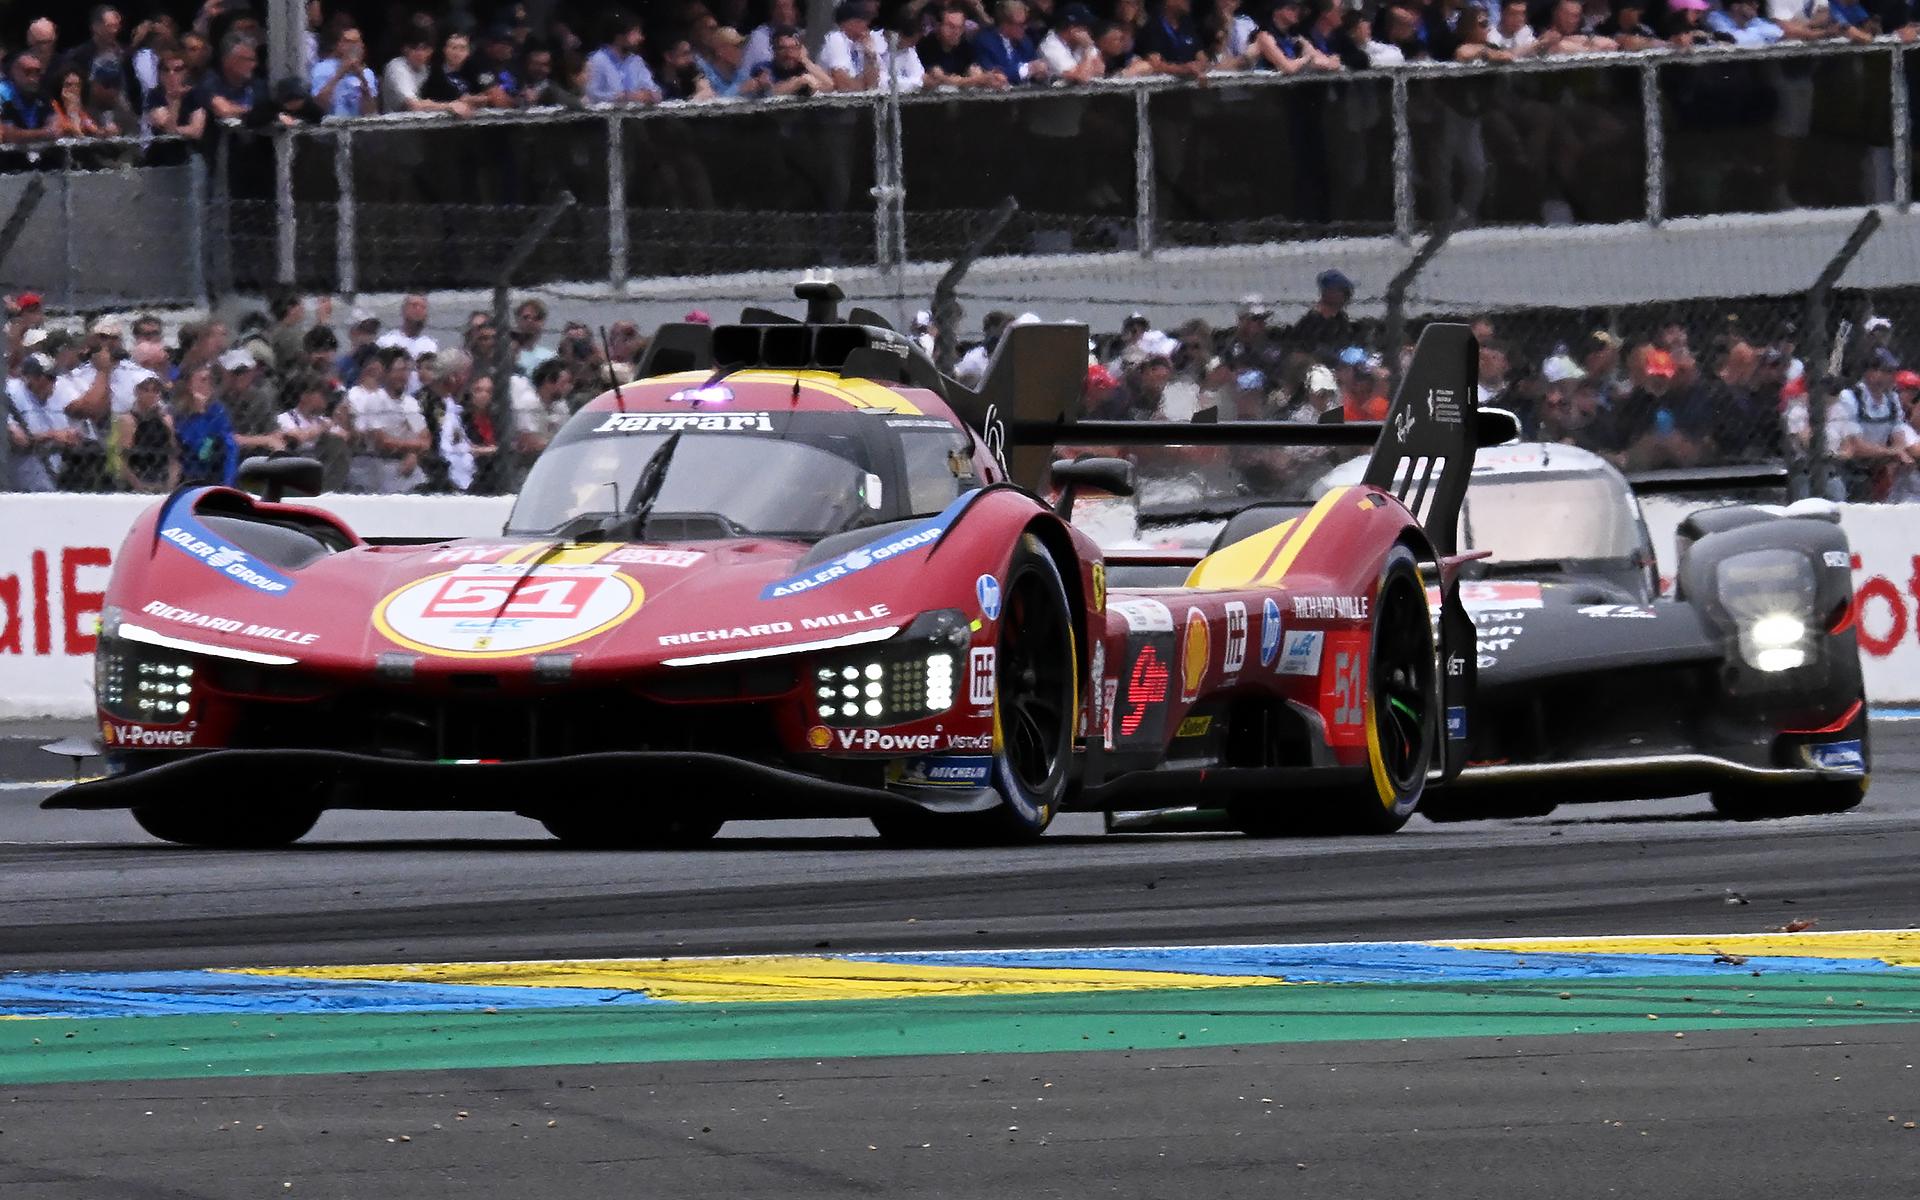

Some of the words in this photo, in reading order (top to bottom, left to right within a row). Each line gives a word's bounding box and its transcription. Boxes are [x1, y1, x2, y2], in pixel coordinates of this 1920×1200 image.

[593, 411, 774, 432] Ferrari
[160, 527, 214, 558] ADLER
[224, 562, 287, 593] GROUP
[772, 565, 848, 598] ADLER
[874, 527, 943, 561] GROUP
[432, 580, 578, 614] 51
[1292, 597, 1336, 619] RICHARD
[1335, 597, 1369, 619] MILLE
[142, 600, 241, 633] RICHARD
[241, 624, 320, 646] MILLE
[658, 621, 793, 647] RICHARD
[801, 603, 892, 629] MILLE
[1334, 652, 1363, 725] 51
[114, 725, 196, 746] V-Power
[837, 729, 939, 750] V-Power
[928, 766, 987, 779] MICHELIN
